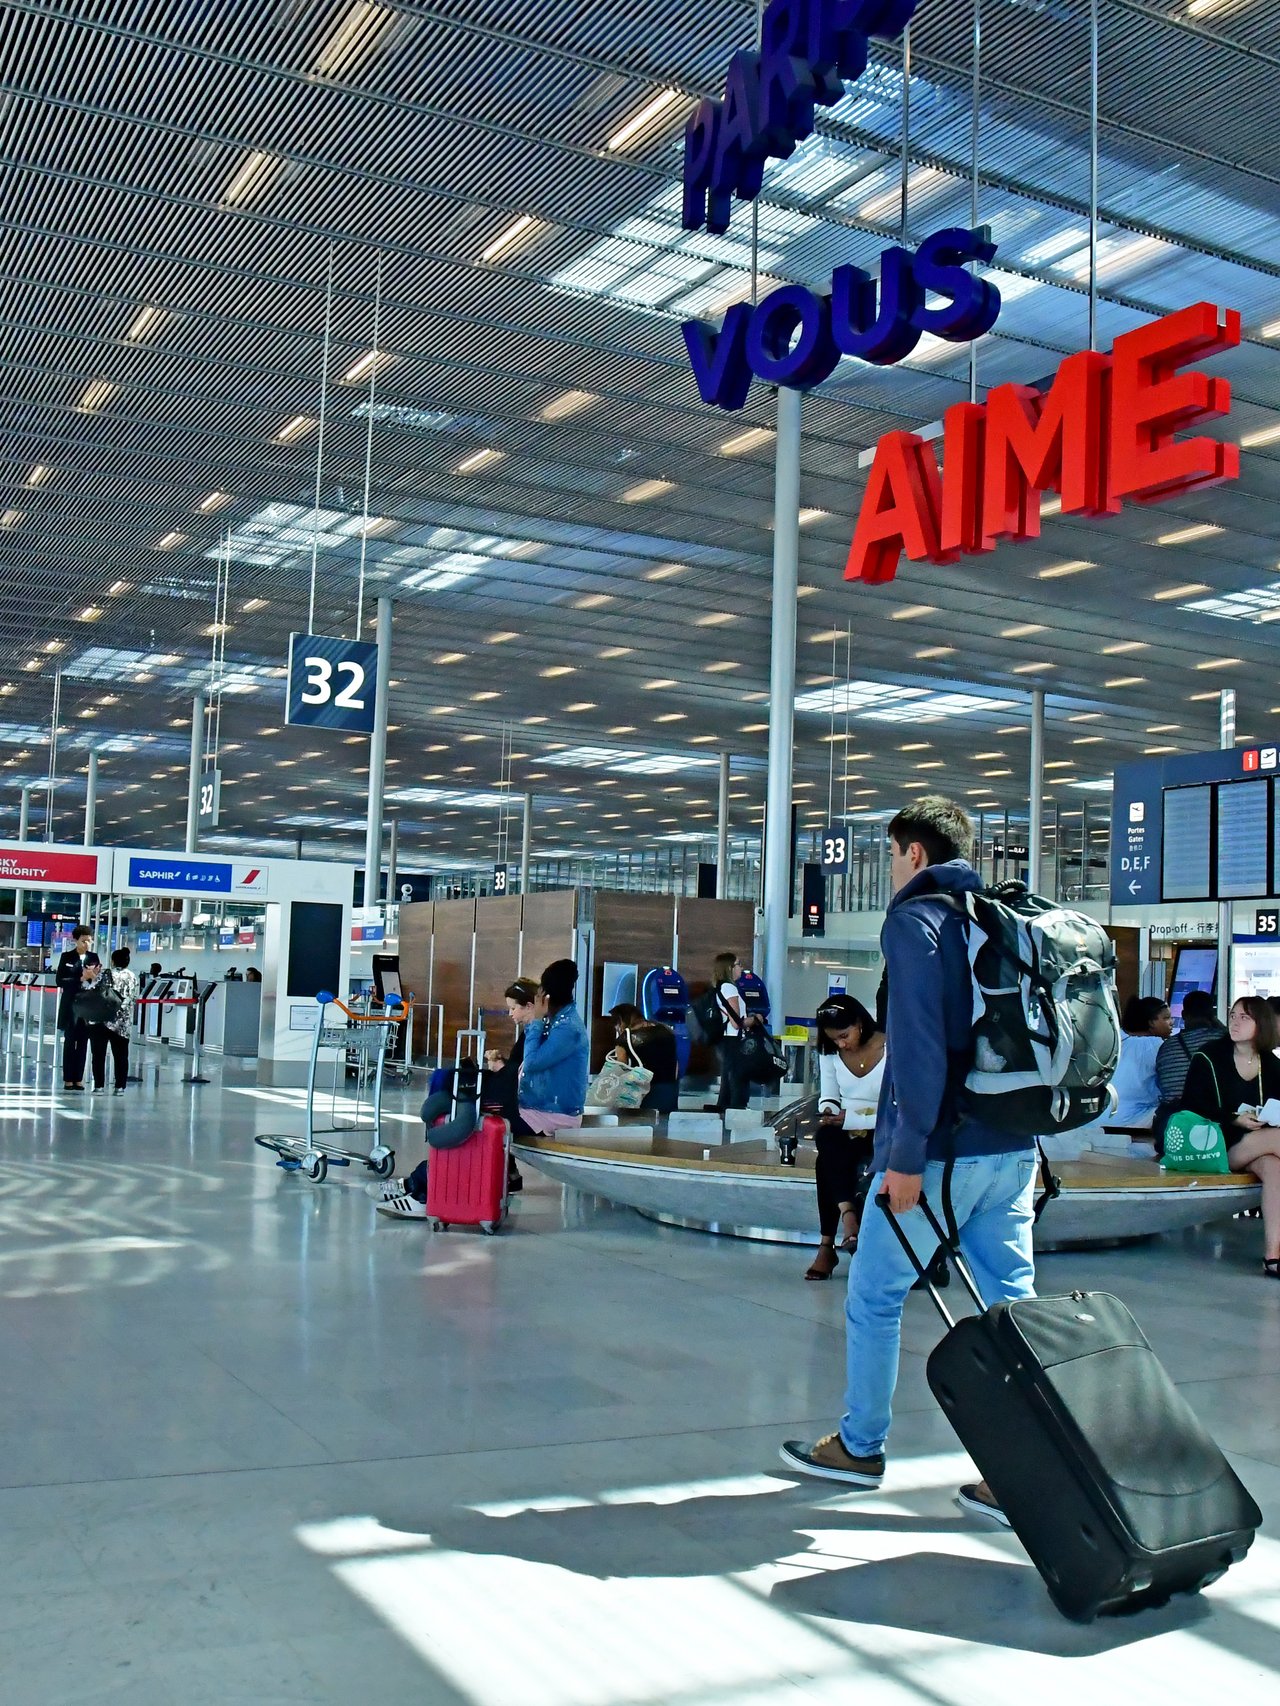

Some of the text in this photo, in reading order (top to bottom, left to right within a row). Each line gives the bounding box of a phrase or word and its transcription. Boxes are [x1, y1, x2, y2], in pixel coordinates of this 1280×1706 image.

[681, 226, 1001, 411] VOUS
[844, 301, 1240, 584] AIME
[301, 656, 365, 710] 32
[200, 784, 213, 815] 32
[1127, 827, 1145, 835] Portes
[824, 838, 846, 864] 33
[0, 868, 47, 877] RIORITY
[1121, 856, 1151, 872] D,E,F
[139, 870, 175, 880] SAPHIR
[494, 871, 506, 890] 33
[1150, 923, 1188, 936] Drop-off
[1257, 915, 1277, 932] 35
